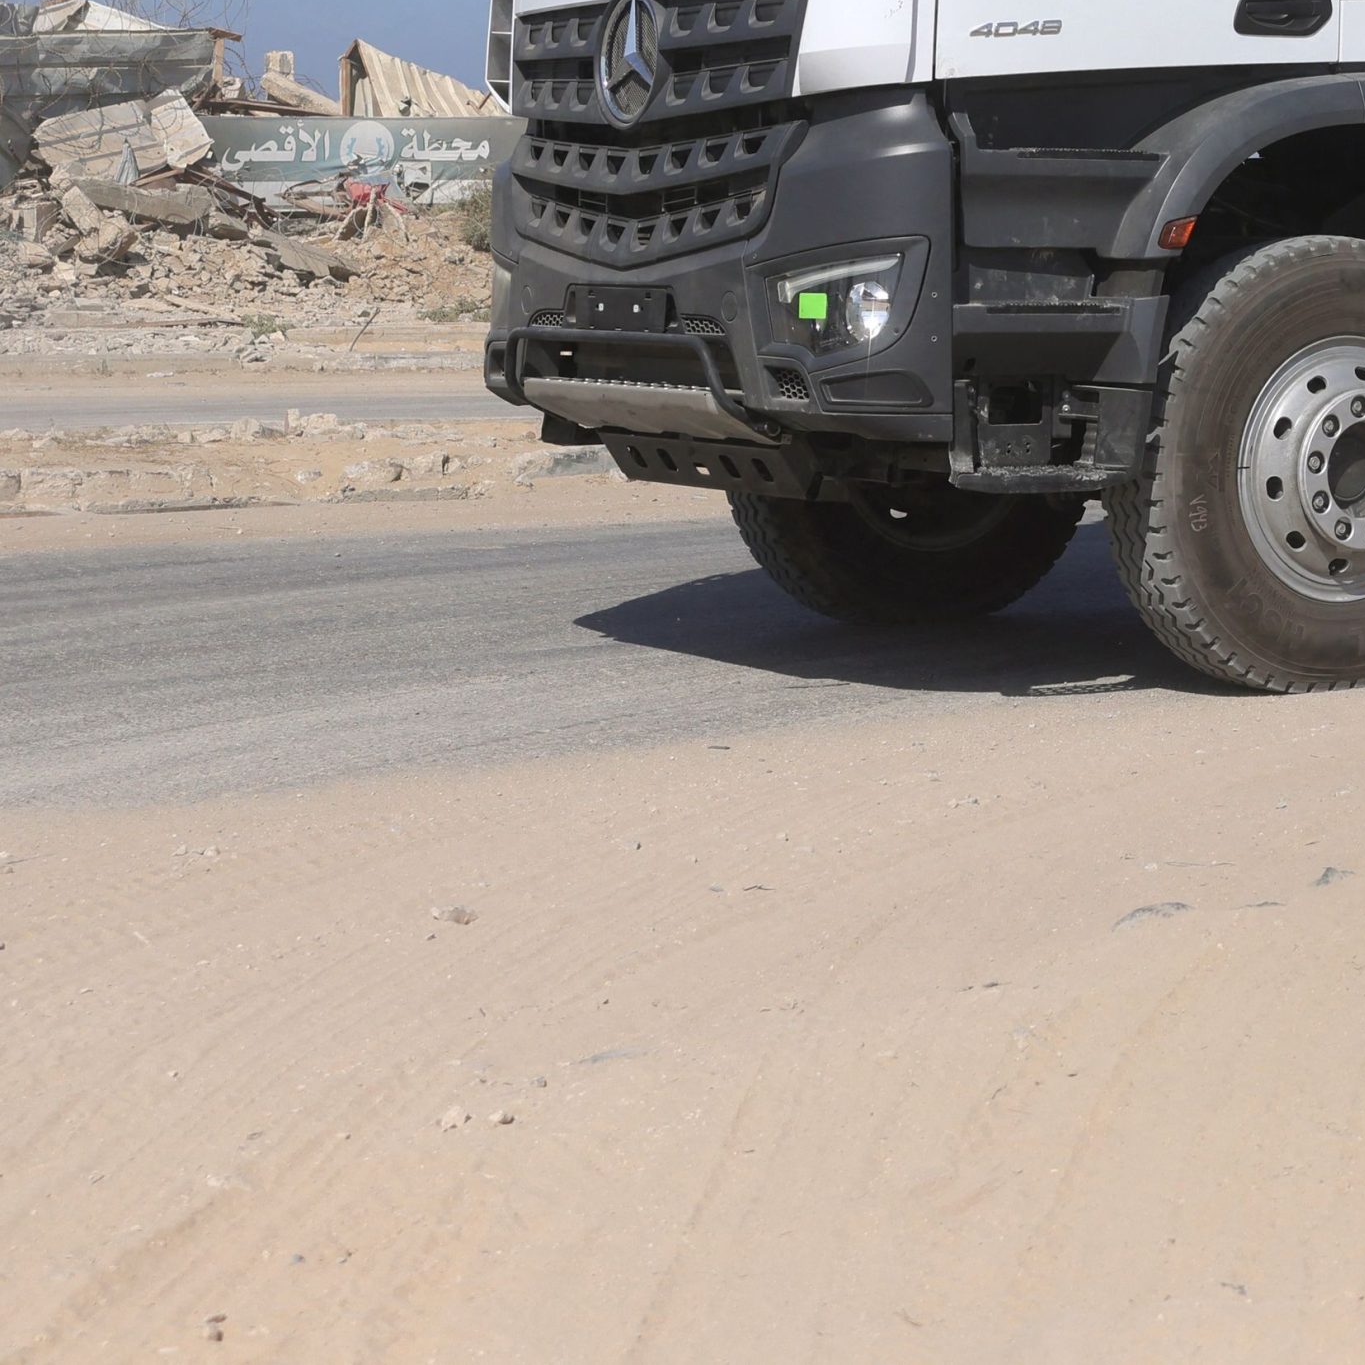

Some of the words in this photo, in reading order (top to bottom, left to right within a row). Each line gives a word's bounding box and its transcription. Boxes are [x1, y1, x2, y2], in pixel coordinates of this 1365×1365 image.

[968, 19, 1062, 38] 4048
[221, 119, 330, 172] الأقصى
[400, 127, 490, 162] محطة
